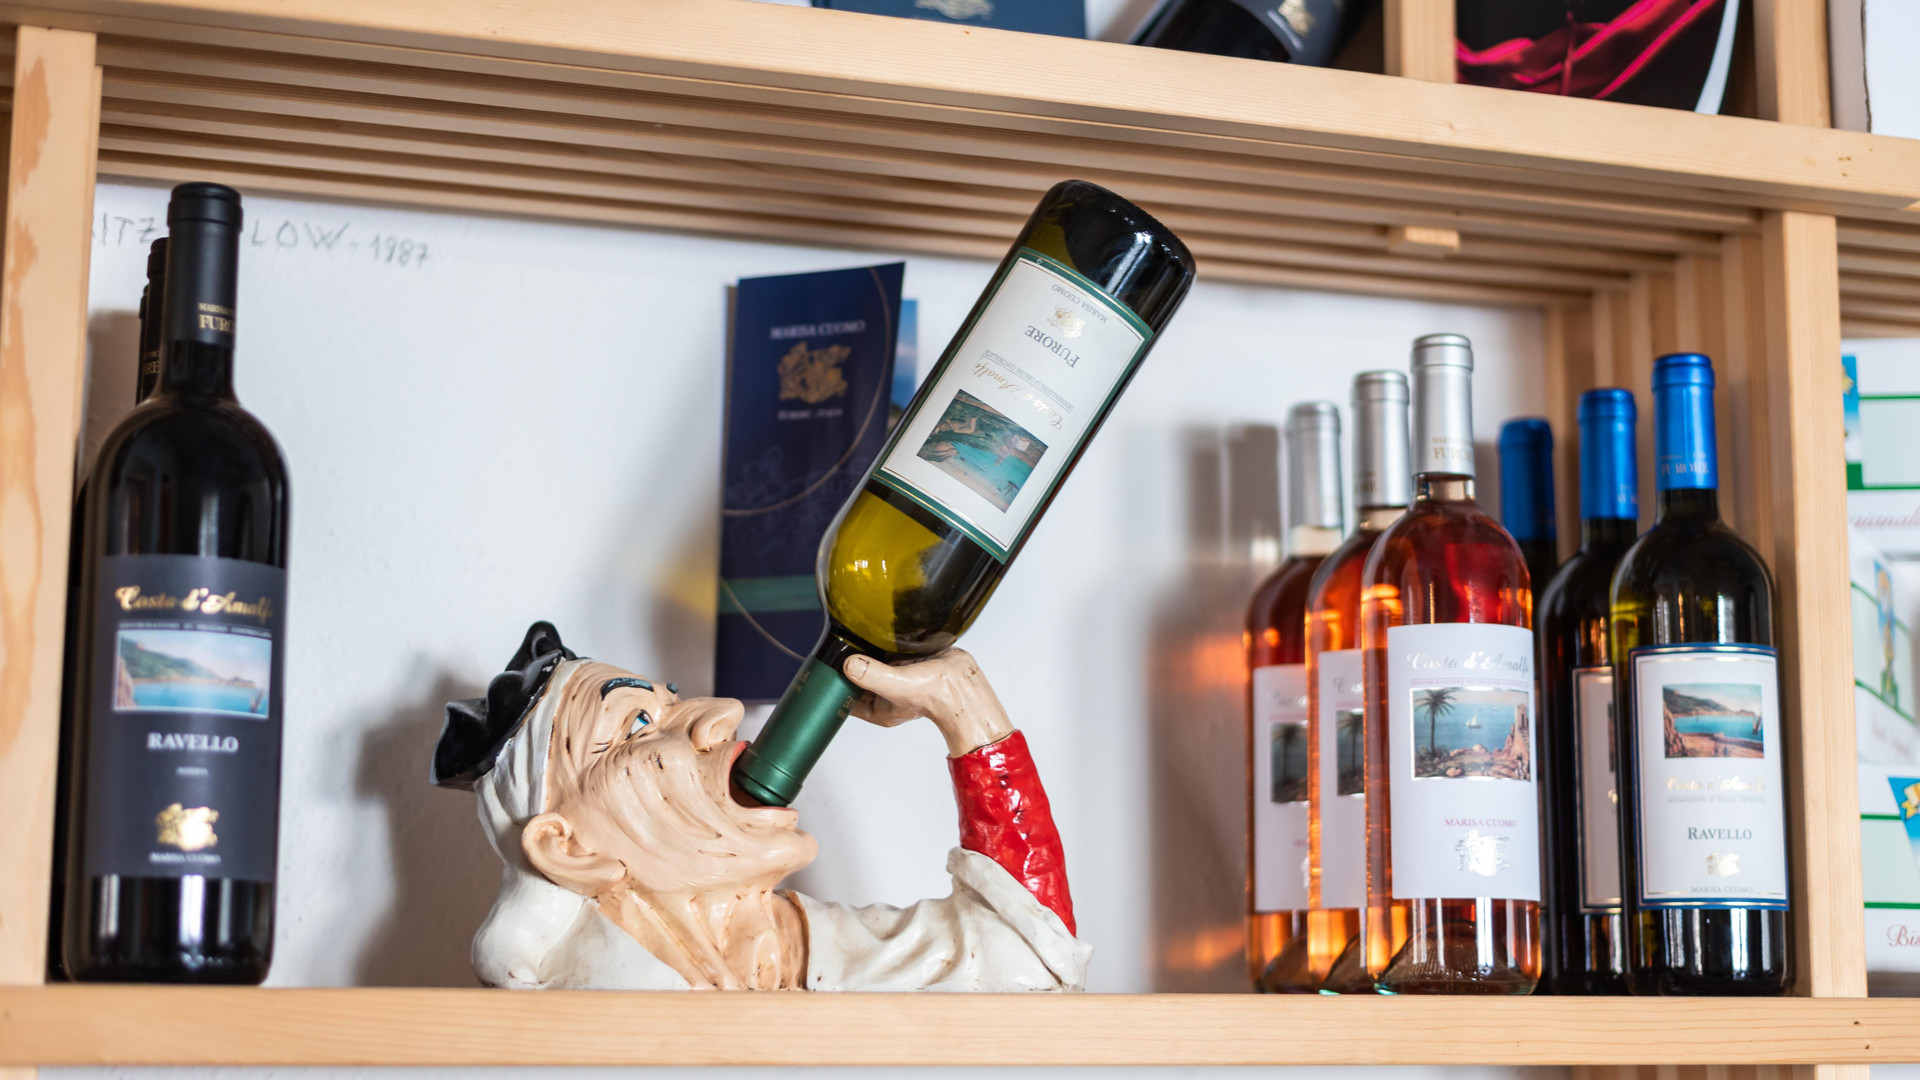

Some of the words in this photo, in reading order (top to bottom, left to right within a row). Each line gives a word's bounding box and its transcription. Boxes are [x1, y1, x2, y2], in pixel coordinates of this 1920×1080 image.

[1051, 283, 1081, 305] CUOMO
[1081, 301, 1108, 324] MARISA
[1024, 325, 1081, 369] FURORE
[147, 732, 239, 752] RAVELLO
[1444, 818, 1484, 827] MARISA
[1486, 818, 1517, 828] CUOMO
[1688, 827, 1752, 841] RAVELLO
